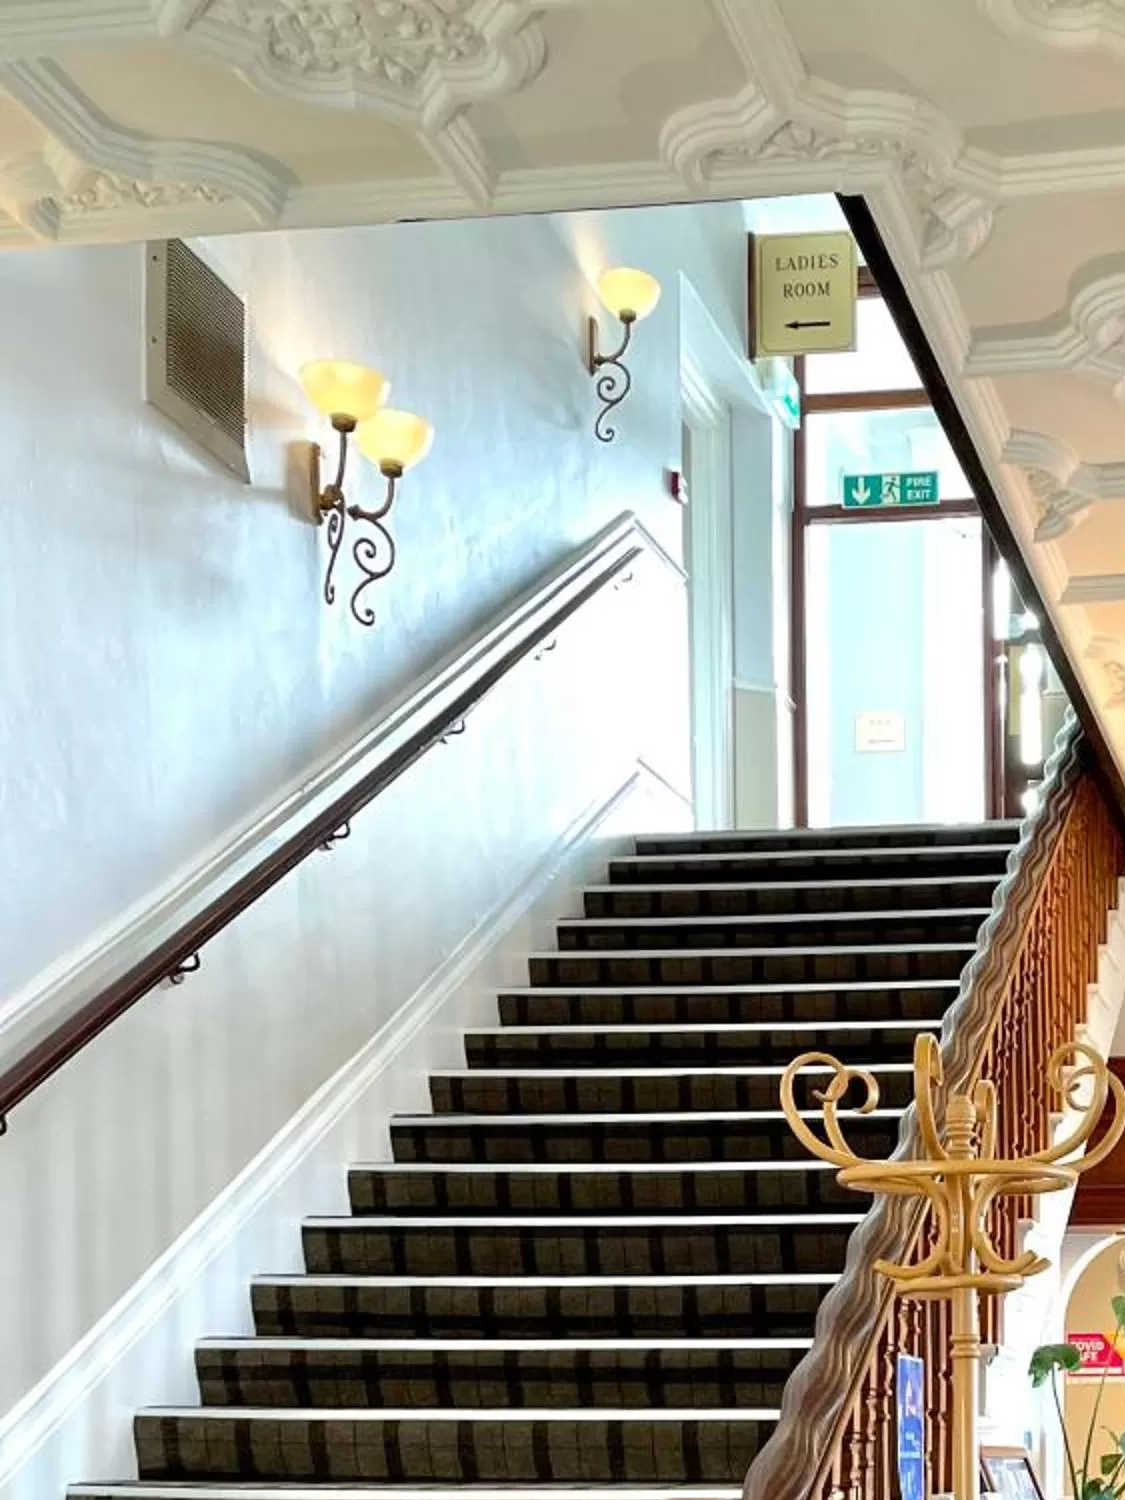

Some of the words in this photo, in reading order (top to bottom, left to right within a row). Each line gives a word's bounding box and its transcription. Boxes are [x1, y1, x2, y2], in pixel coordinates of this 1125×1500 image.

[775, 253, 840, 272] LADIES
[783, 281, 831, 298] ROOM
[906, 475, 932, 487] FIRE
[906, 489, 932, 500] EXIT
